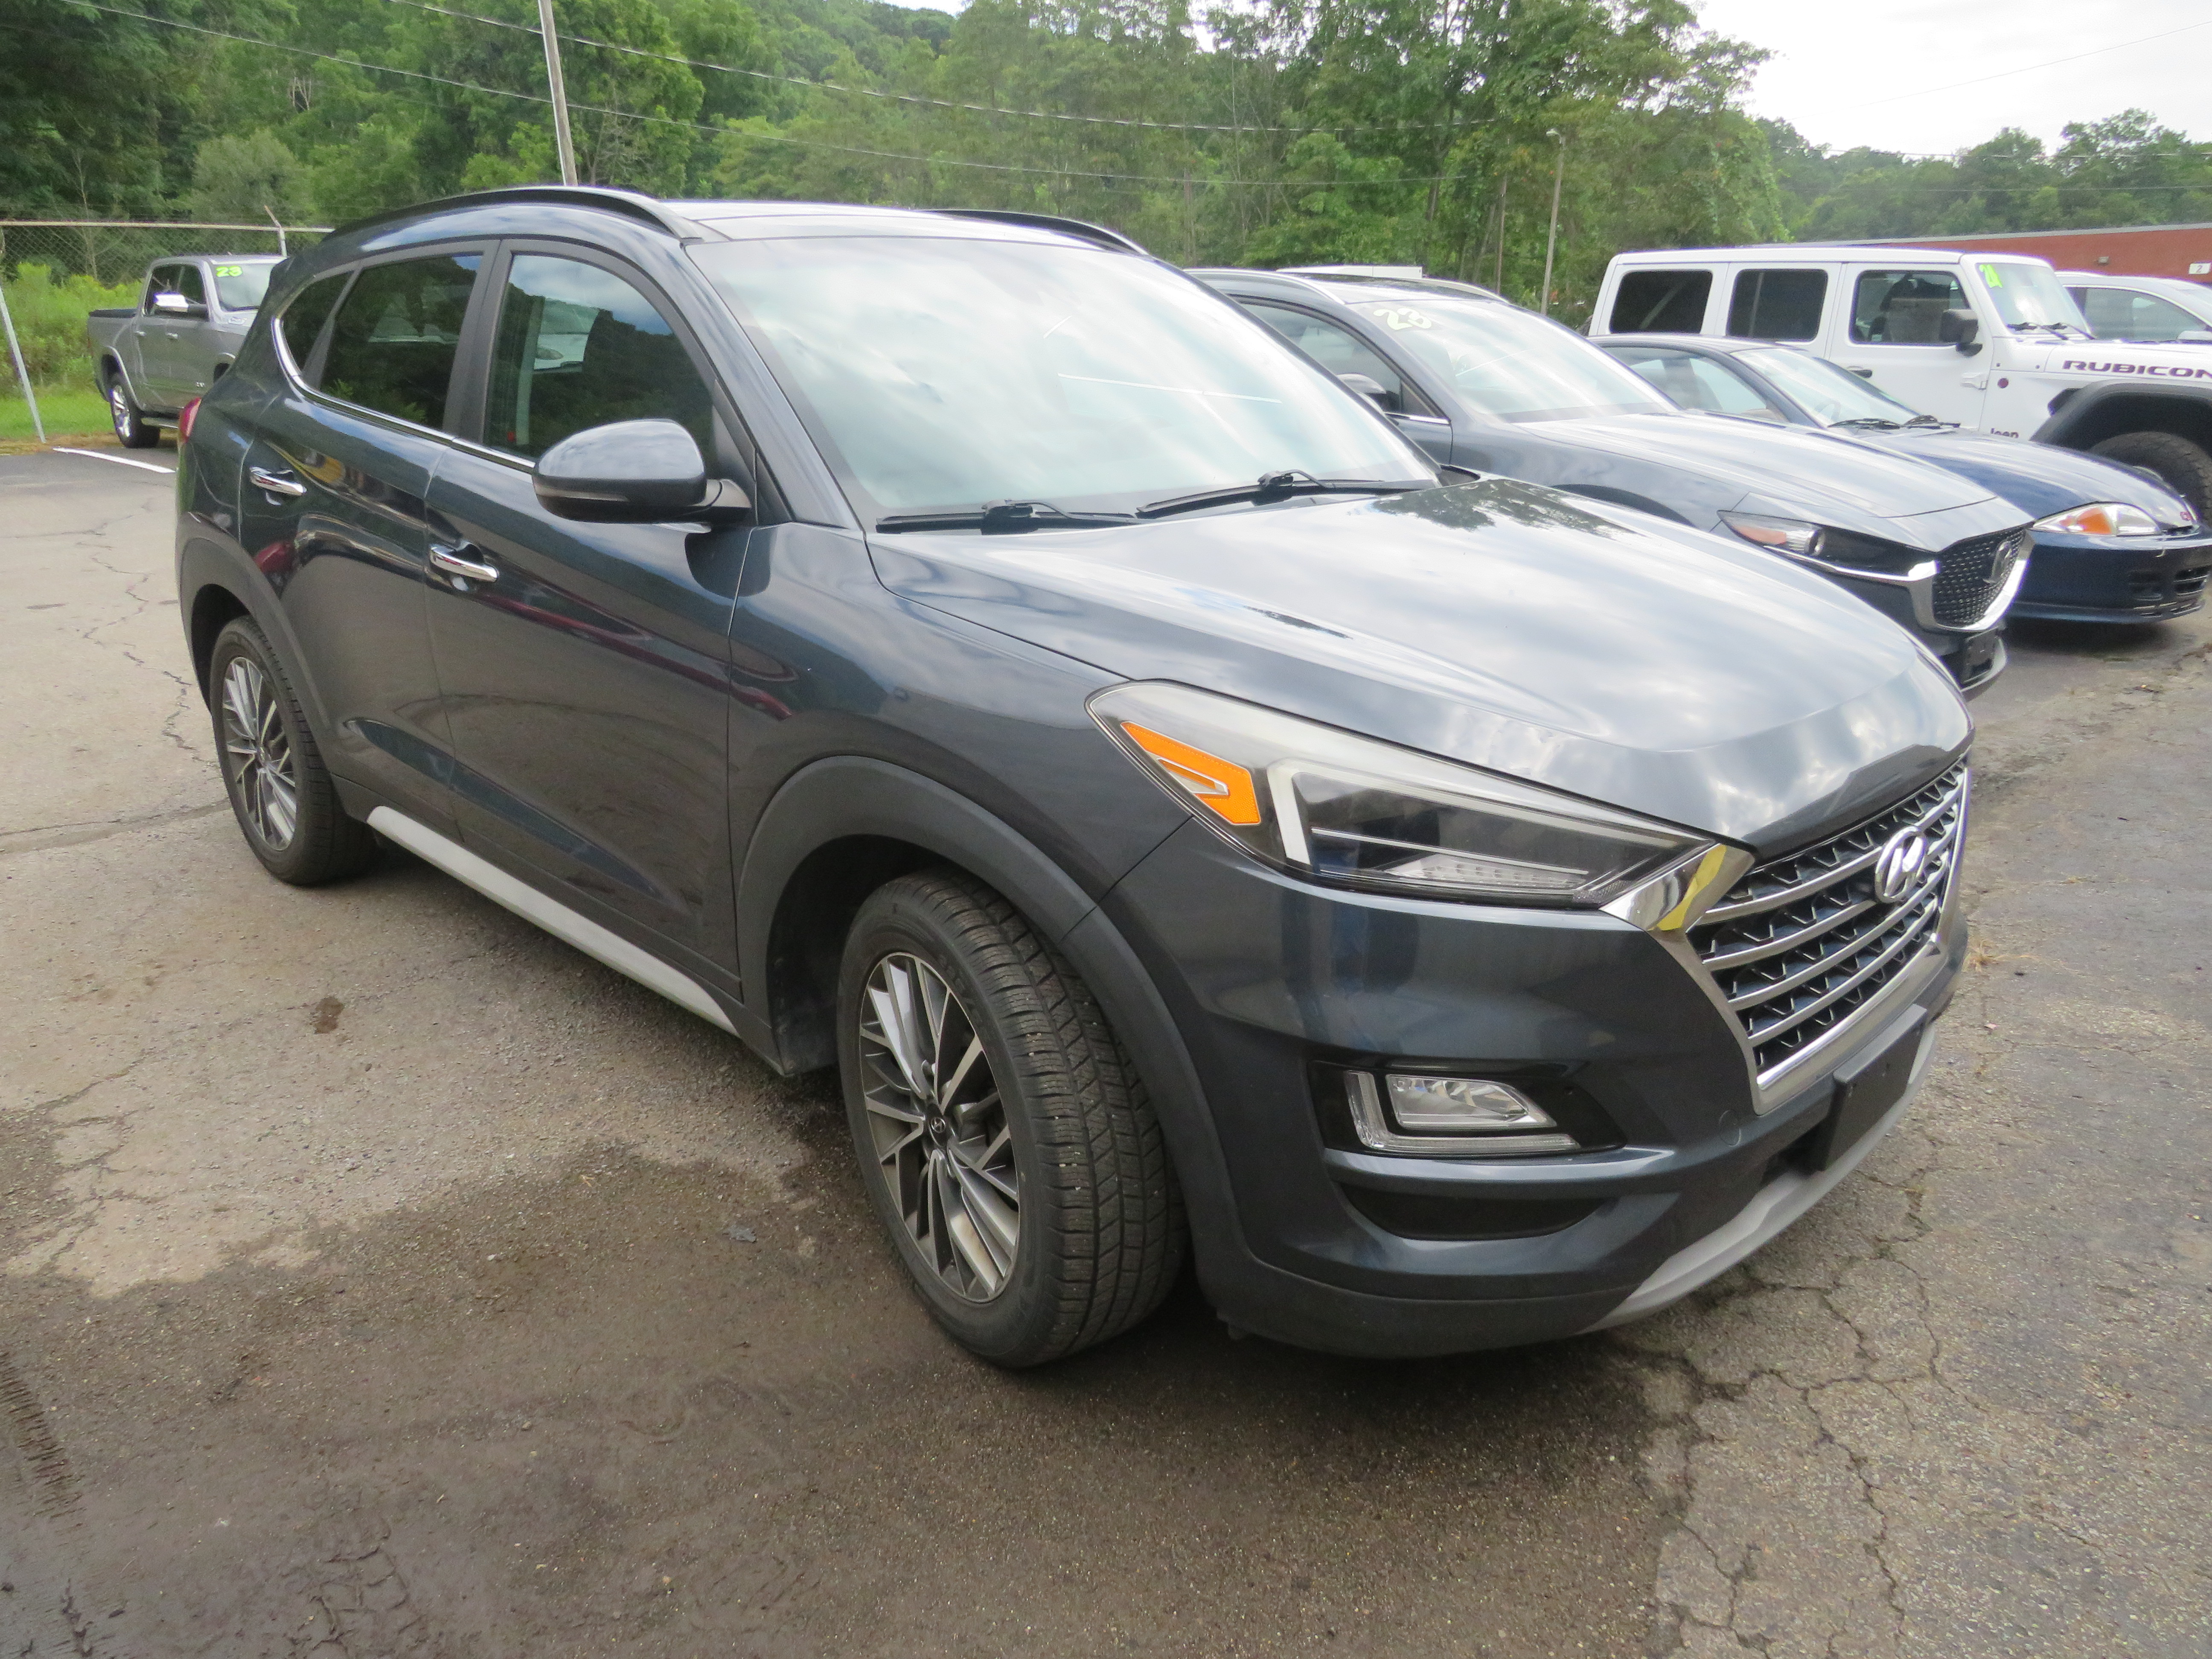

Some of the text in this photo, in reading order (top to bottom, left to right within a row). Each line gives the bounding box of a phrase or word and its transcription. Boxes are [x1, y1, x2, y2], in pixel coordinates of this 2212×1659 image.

[216, 265, 243, 277] 23
[2196, 265, 2203, 273] 2
[1373, 307, 1432, 330] 23
[2062, 360, 2212, 379] RUBICON
